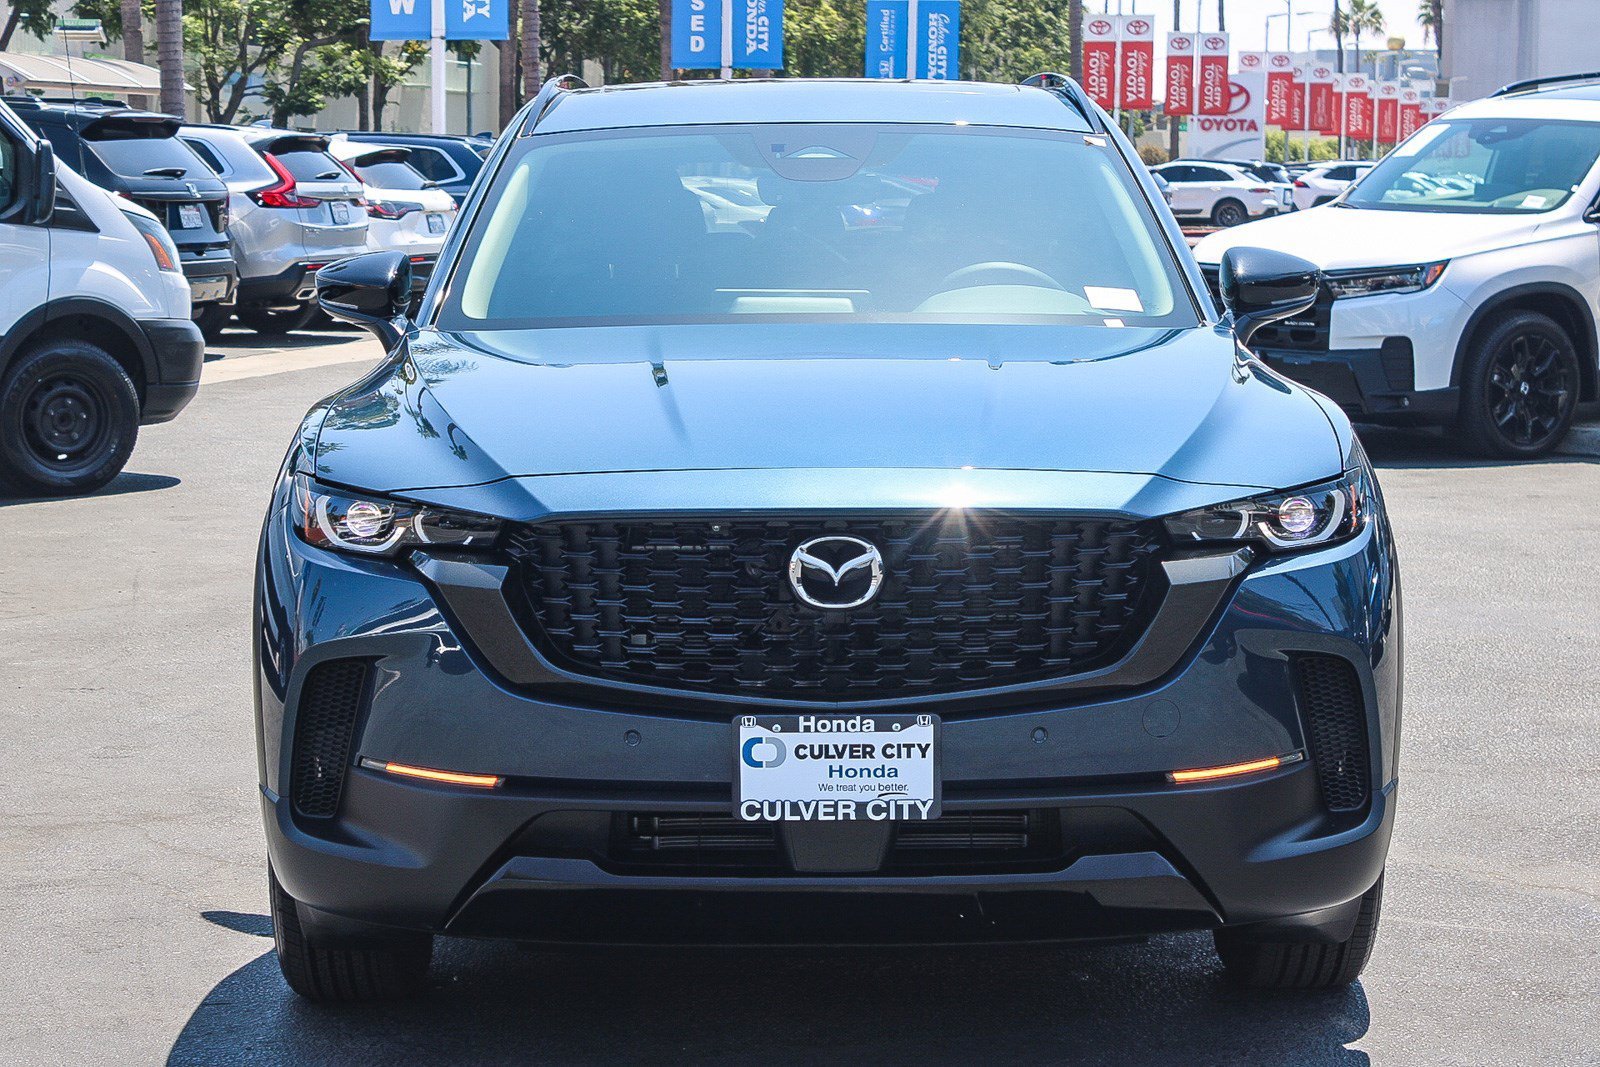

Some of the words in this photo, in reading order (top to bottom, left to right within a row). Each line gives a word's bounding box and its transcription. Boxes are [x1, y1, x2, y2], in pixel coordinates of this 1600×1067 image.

[758, 15, 770, 52] CITY
[879, 9, 890, 52] Certified
[927, 12, 938, 80] HONDA
[1089, 49, 1100, 101] TOYOTA
[1127, 49, 1138, 103] TOYOTA
[1170, 63, 1181, 110] TOYOTA
[1204, 63, 1215, 110] TOYOTA
[1100, 76, 1108, 100] CITY
[1137, 76, 1146, 100] CITY
[1180, 87, 1188, 108] CITY
[1214, 87, 1222, 108] CITY
[1271, 78, 1280, 120] TOYOTA
[1191, 118, 1258, 132] OYOTA
[1349, 97, 1357, 132] TOYOTA
[799, 715, 875, 733] Honda
[794, 743, 876, 760] CULVER
[881, 743, 931, 759] CITY
[828, 764, 898, 778] Honda
[818, 783, 834, 792] We
[836, 783, 857, 792] treat
[859, 785, 876, 794] you
[878, 783, 909, 792] better.
[740, 799, 857, 821] CULVER
[866, 799, 934, 821] CITY
